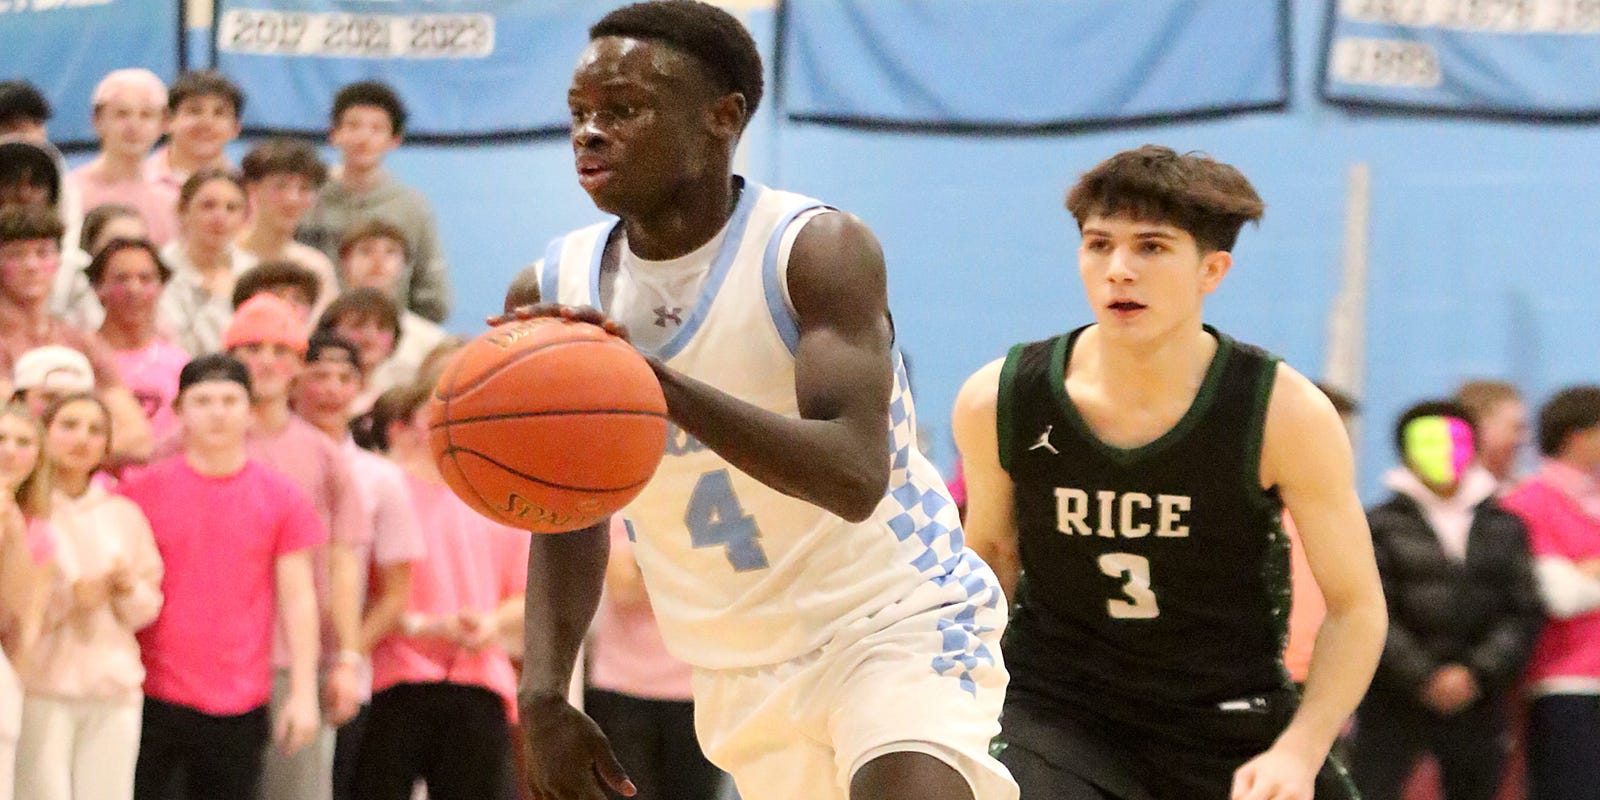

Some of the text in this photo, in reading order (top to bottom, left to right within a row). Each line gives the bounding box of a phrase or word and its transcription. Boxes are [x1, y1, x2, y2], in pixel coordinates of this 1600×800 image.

[684, 467, 770, 573] 4
[1054, 486, 1192, 538] RICE
[1097, 552, 1160, 620] 3
